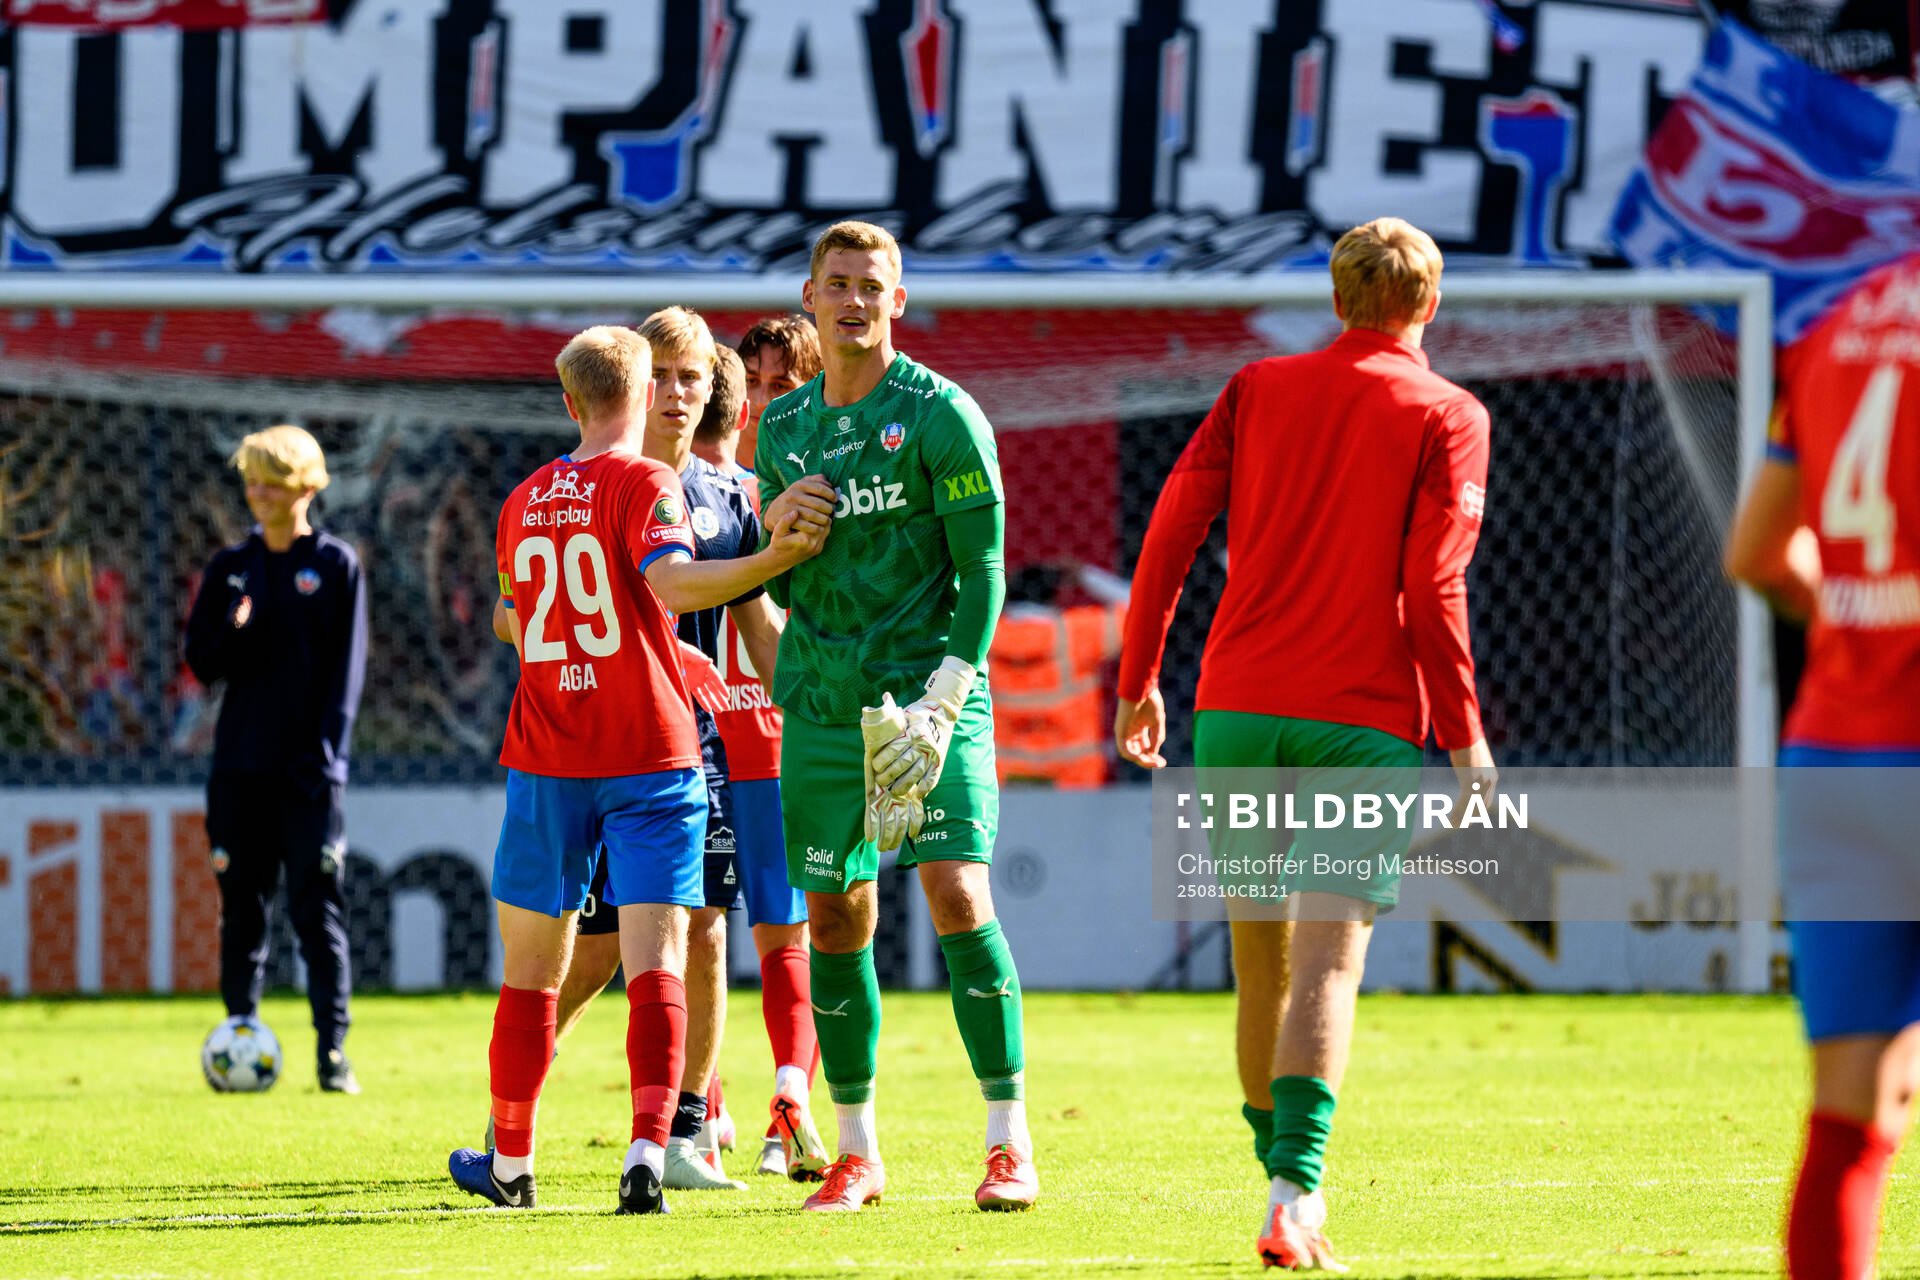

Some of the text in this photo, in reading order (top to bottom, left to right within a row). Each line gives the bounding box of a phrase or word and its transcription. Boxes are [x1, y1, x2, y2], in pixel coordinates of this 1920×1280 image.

[1821, 362, 1904, 576] 4
[943, 470, 990, 502] XXL
[514, 533, 621, 664] 29
[558, 662, 598, 692] AGA
[805, 846, 834, 865] Solid
[804, 863, 843, 881] Försäkring
